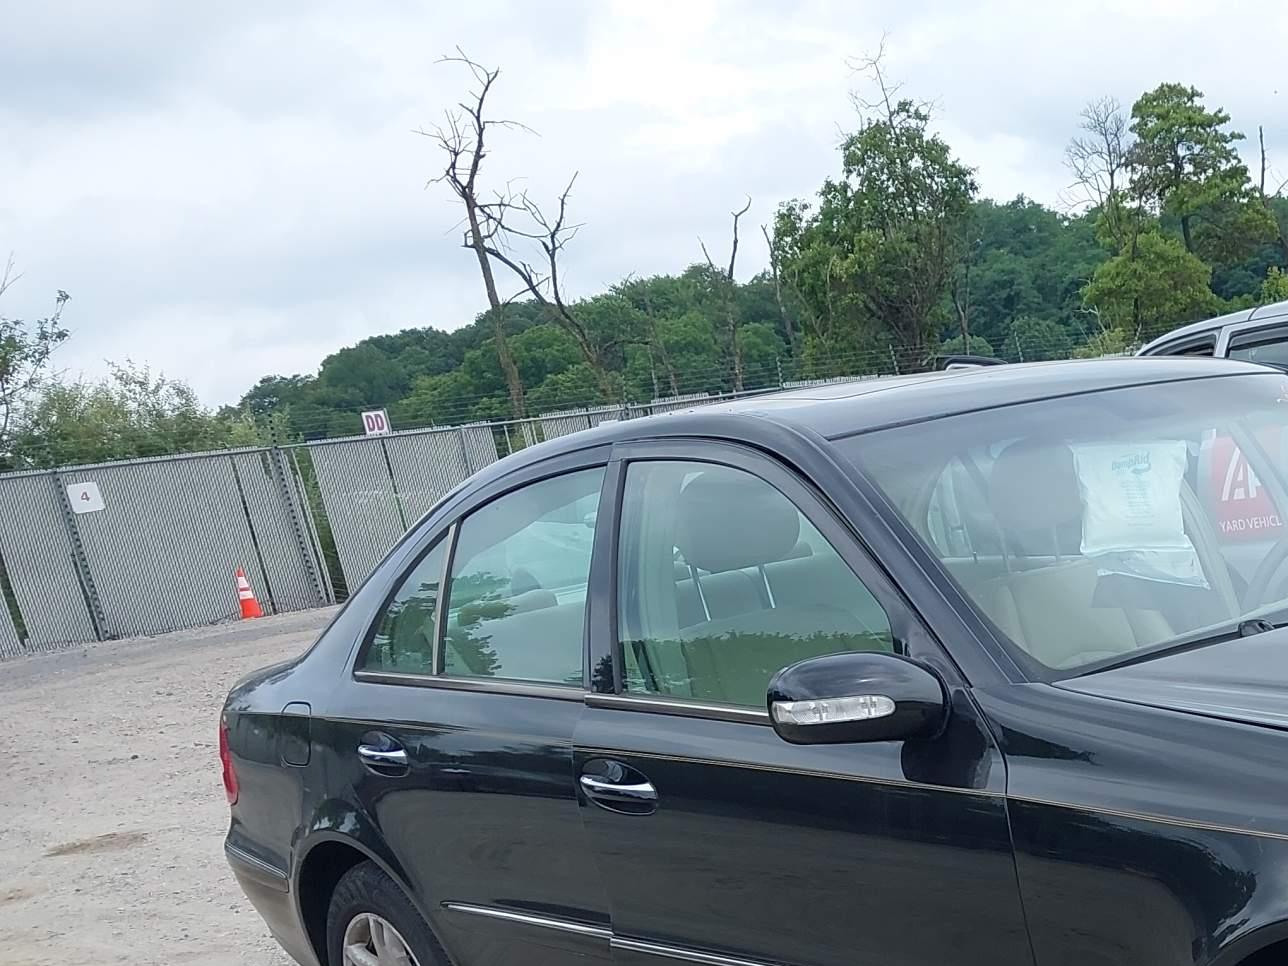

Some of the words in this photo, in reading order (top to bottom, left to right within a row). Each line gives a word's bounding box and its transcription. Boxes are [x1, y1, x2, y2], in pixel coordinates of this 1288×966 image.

[81, 491, 90, 501] 4
[1219, 519, 1246, 533] YARD
[1247, 515, 1282, 529] VEHICL
